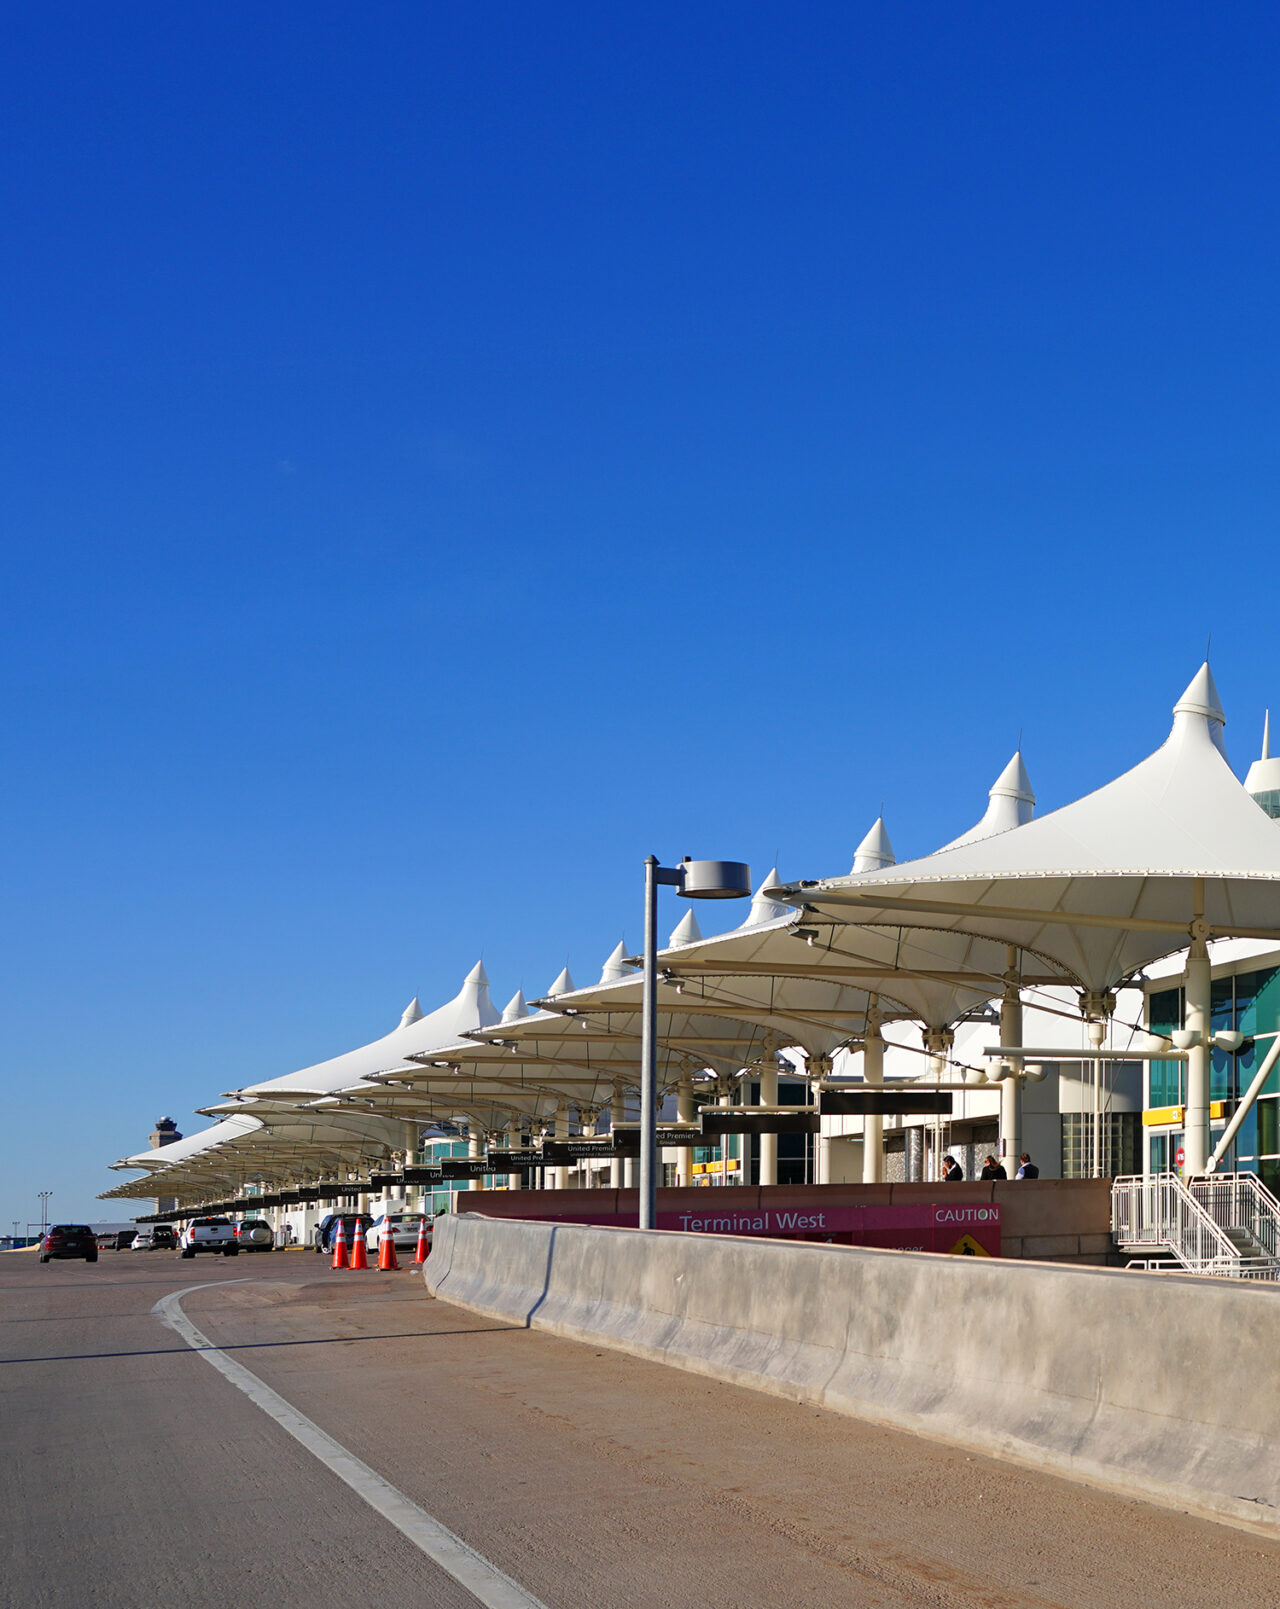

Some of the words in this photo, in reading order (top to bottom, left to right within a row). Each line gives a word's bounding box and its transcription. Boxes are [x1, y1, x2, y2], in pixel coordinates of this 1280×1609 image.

[679, 1212, 769, 1231] Terminal
[775, 1212, 826, 1229] West
[935, 1208, 998, 1222] CAUTION
